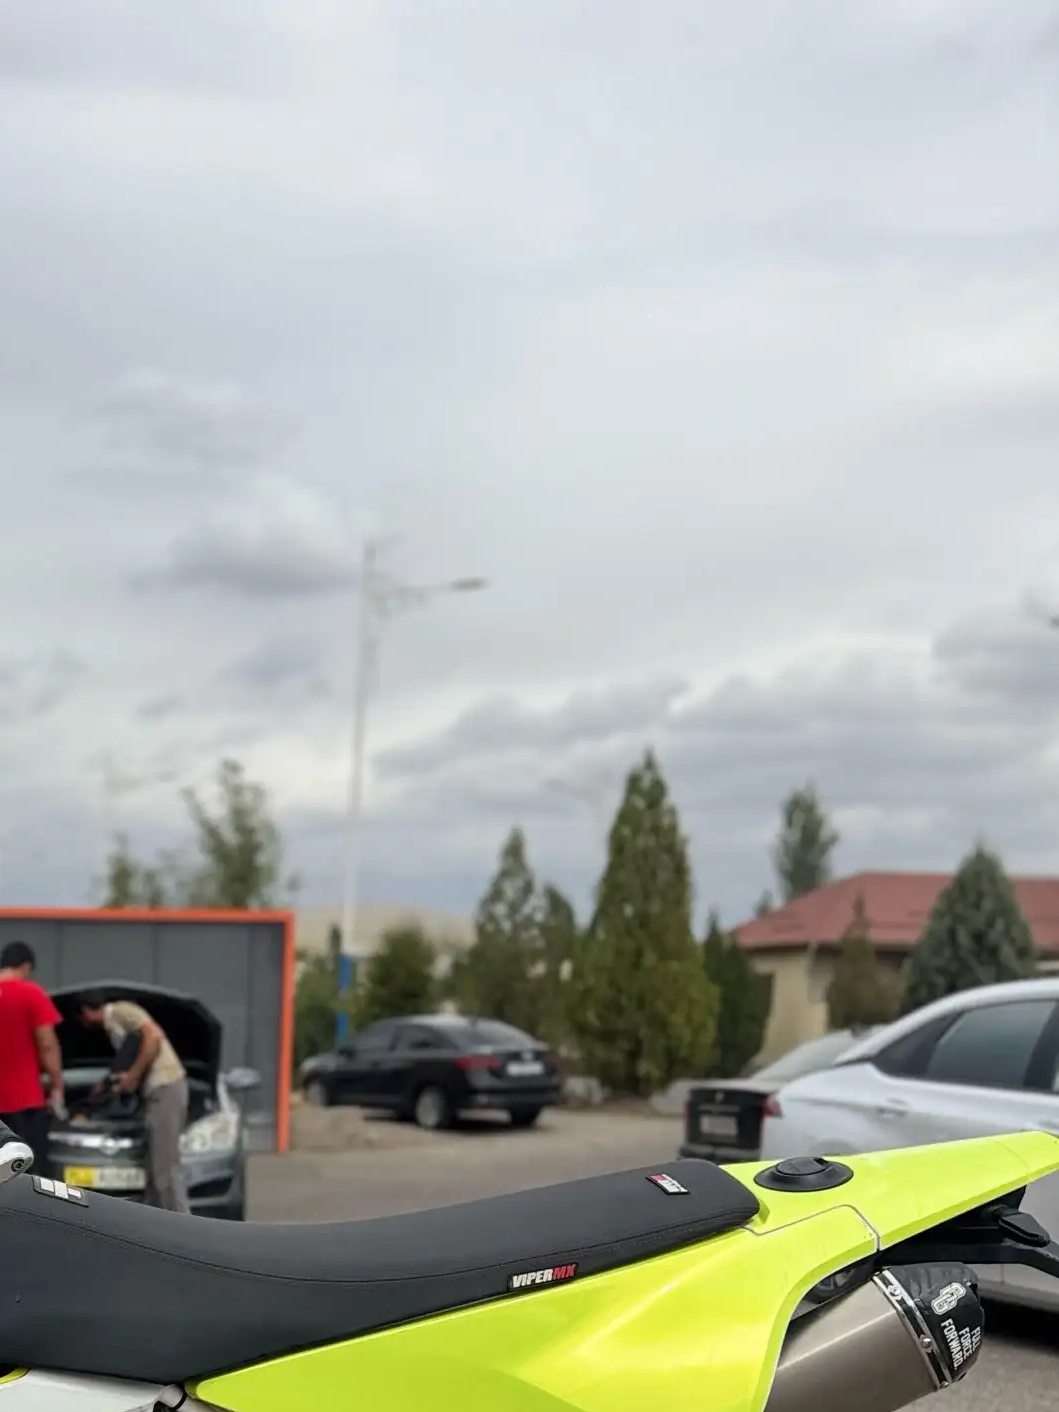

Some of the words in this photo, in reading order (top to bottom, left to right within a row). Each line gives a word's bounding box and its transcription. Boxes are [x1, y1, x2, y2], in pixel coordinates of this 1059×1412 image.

[512, 1263, 578, 1288] VIPERMX
[959, 1326, 973, 1360] FORCE
[971, 1326, 982, 1352] FULL
